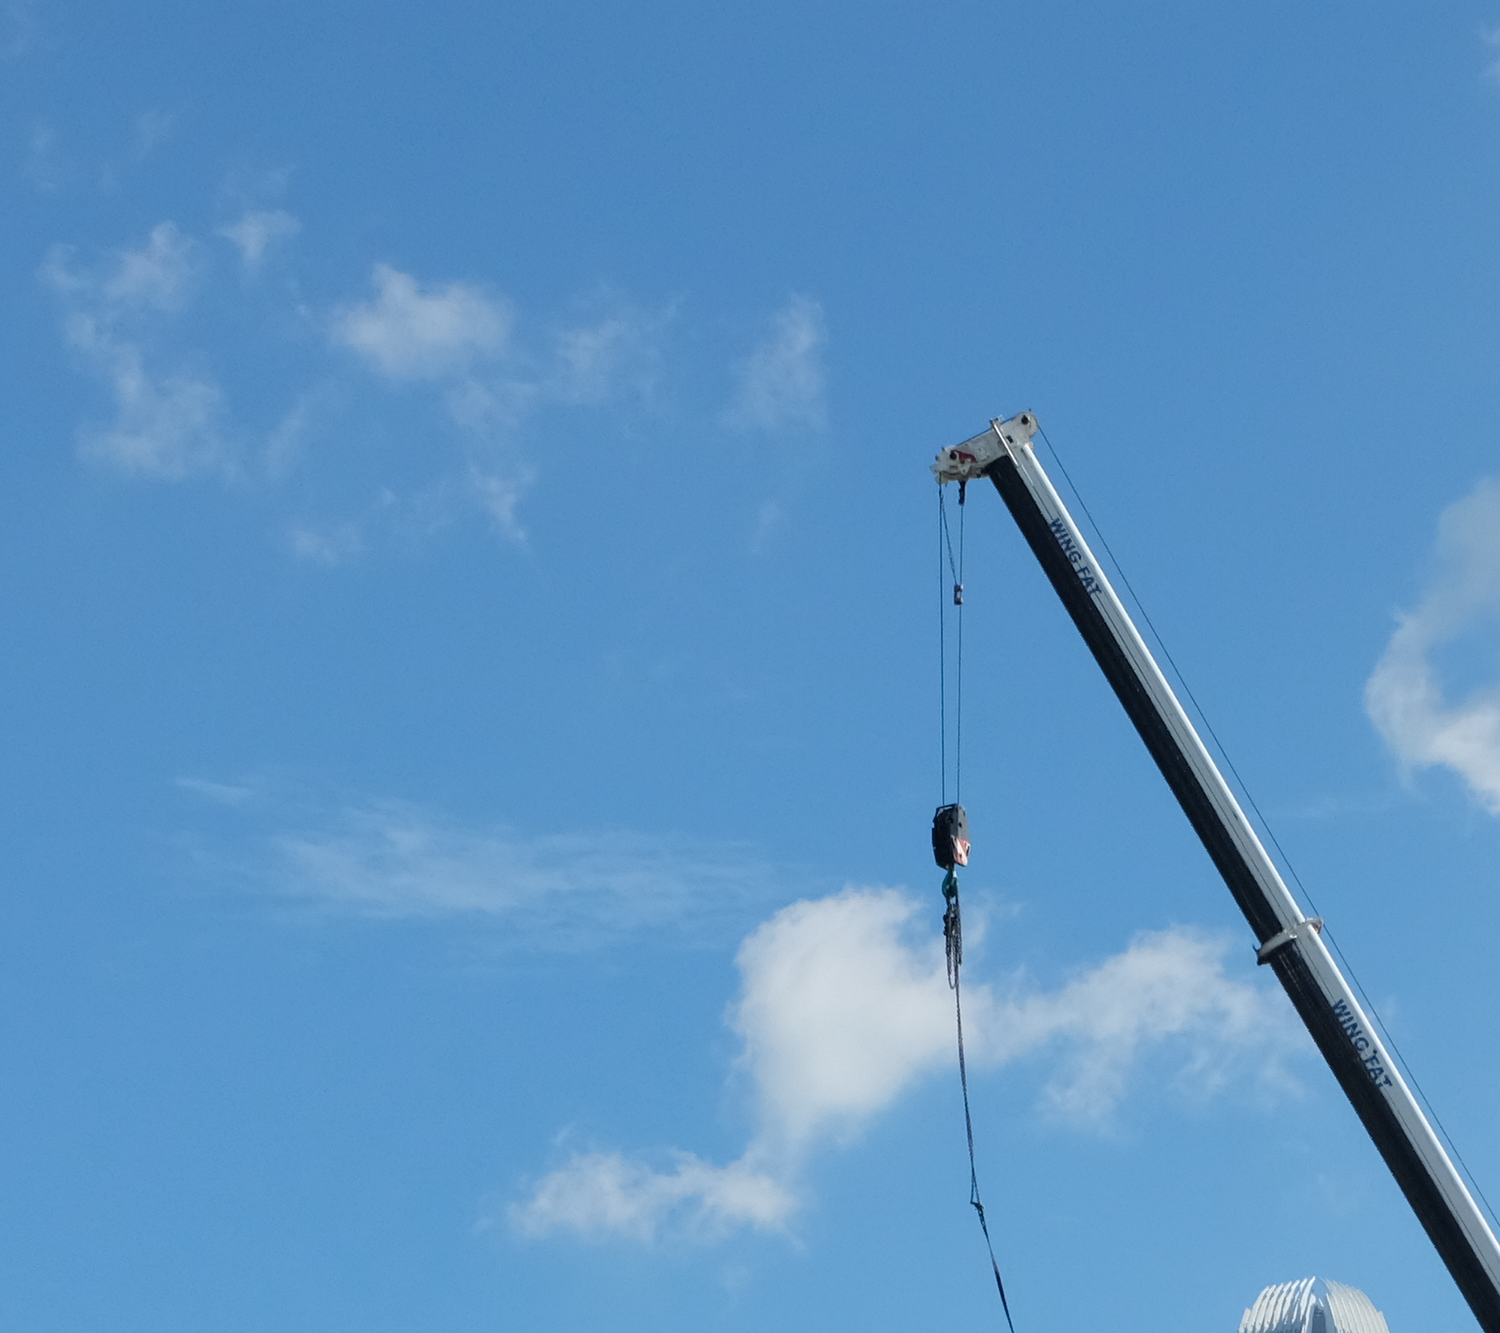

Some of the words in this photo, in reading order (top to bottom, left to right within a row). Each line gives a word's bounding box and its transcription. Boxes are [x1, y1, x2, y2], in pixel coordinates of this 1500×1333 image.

[1049, 518, 1082, 564] WING
[1077, 566, 1102, 595] FAT
[1332, 999, 1370, 1052] WING
[1364, 1055, 1393, 1088] FAT
